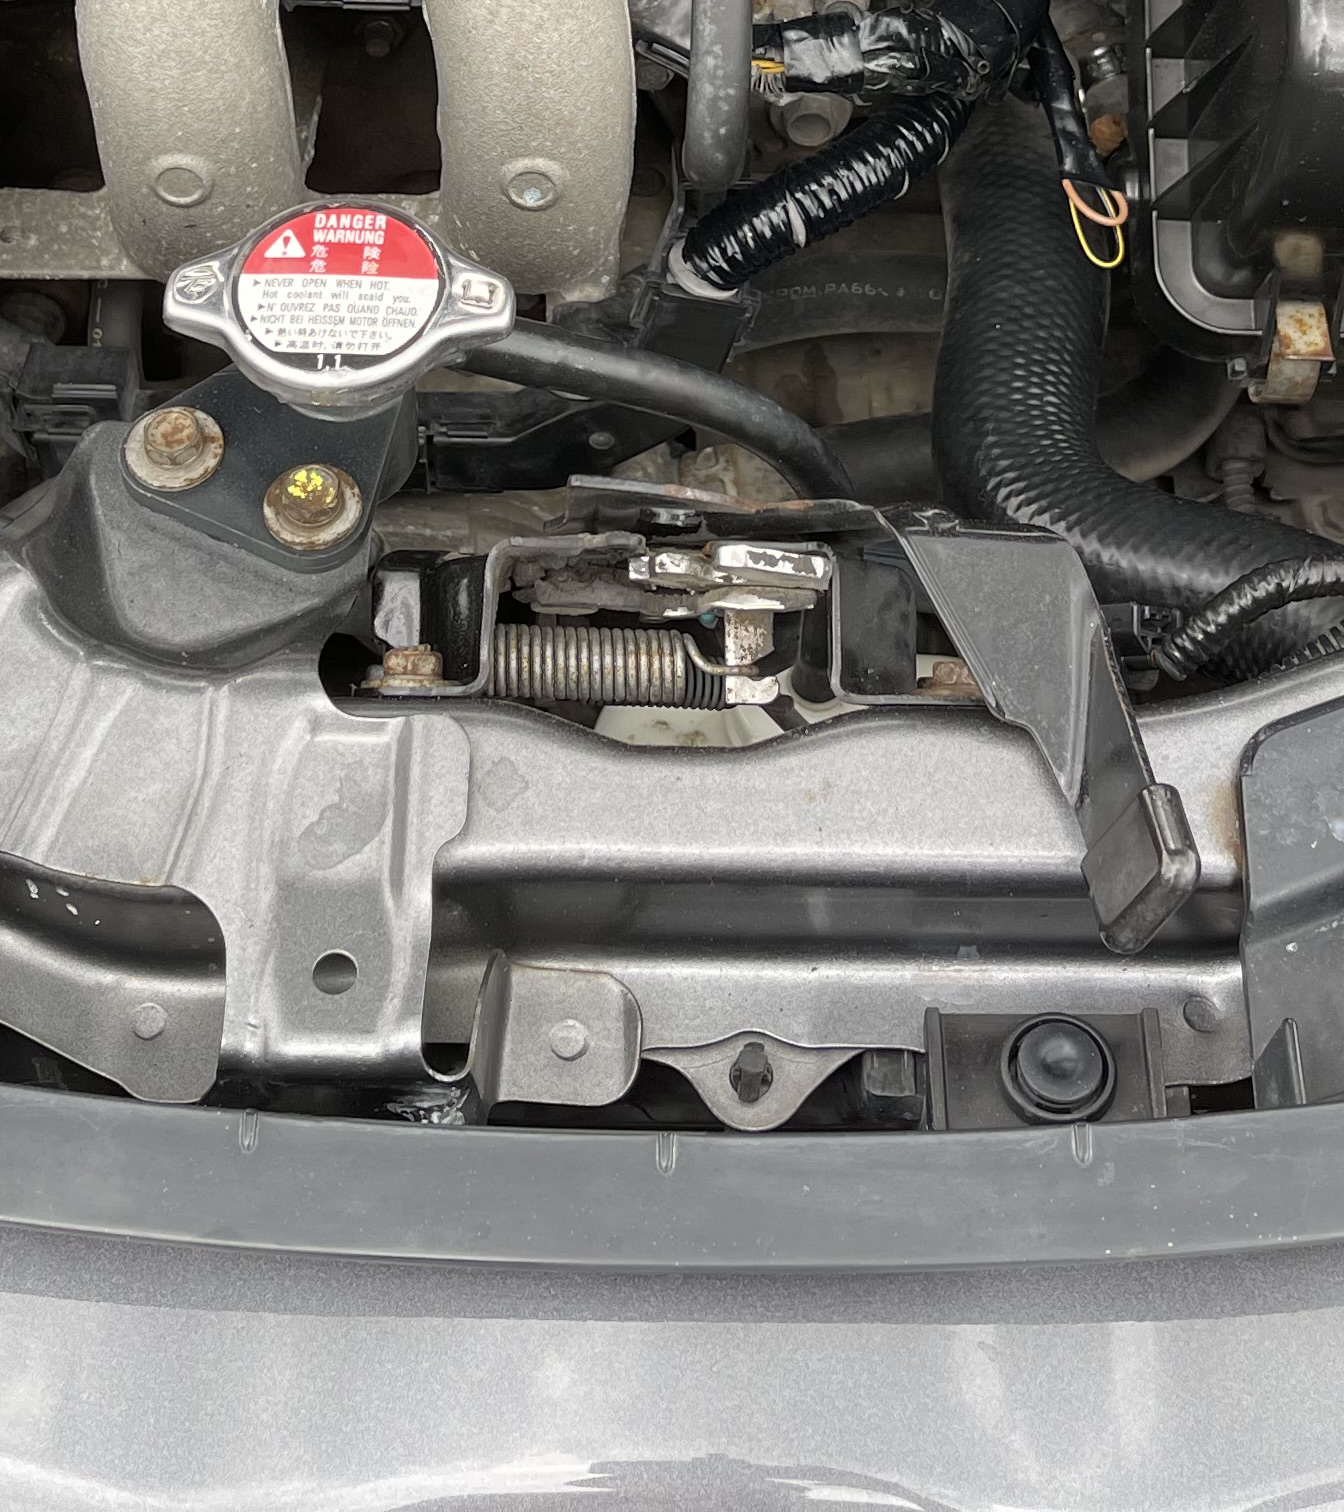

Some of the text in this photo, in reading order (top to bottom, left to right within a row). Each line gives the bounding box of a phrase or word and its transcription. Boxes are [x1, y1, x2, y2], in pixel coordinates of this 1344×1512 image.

[314, 213, 387, 230] DANGER
[313, 229, 385, 245] WARNUNG
[264, 277, 294, 288] NEVER
[301, 278, 328, 288] OPEN
[336, 279, 363, 289] WHEN
[262, 289, 278, 299] Hot
[287, 290, 323, 300] coolant
[331, 290, 349, 300] will
[323, 303, 341, 313] PAS
[260, 314, 286, 325] NICHT
[290, 314, 304, 325] BEI
[308, 315, 345, 326] HEISSEM
[349, 316, 378, 327] MOTOR
[316, 353, 342, 371] 1.1
